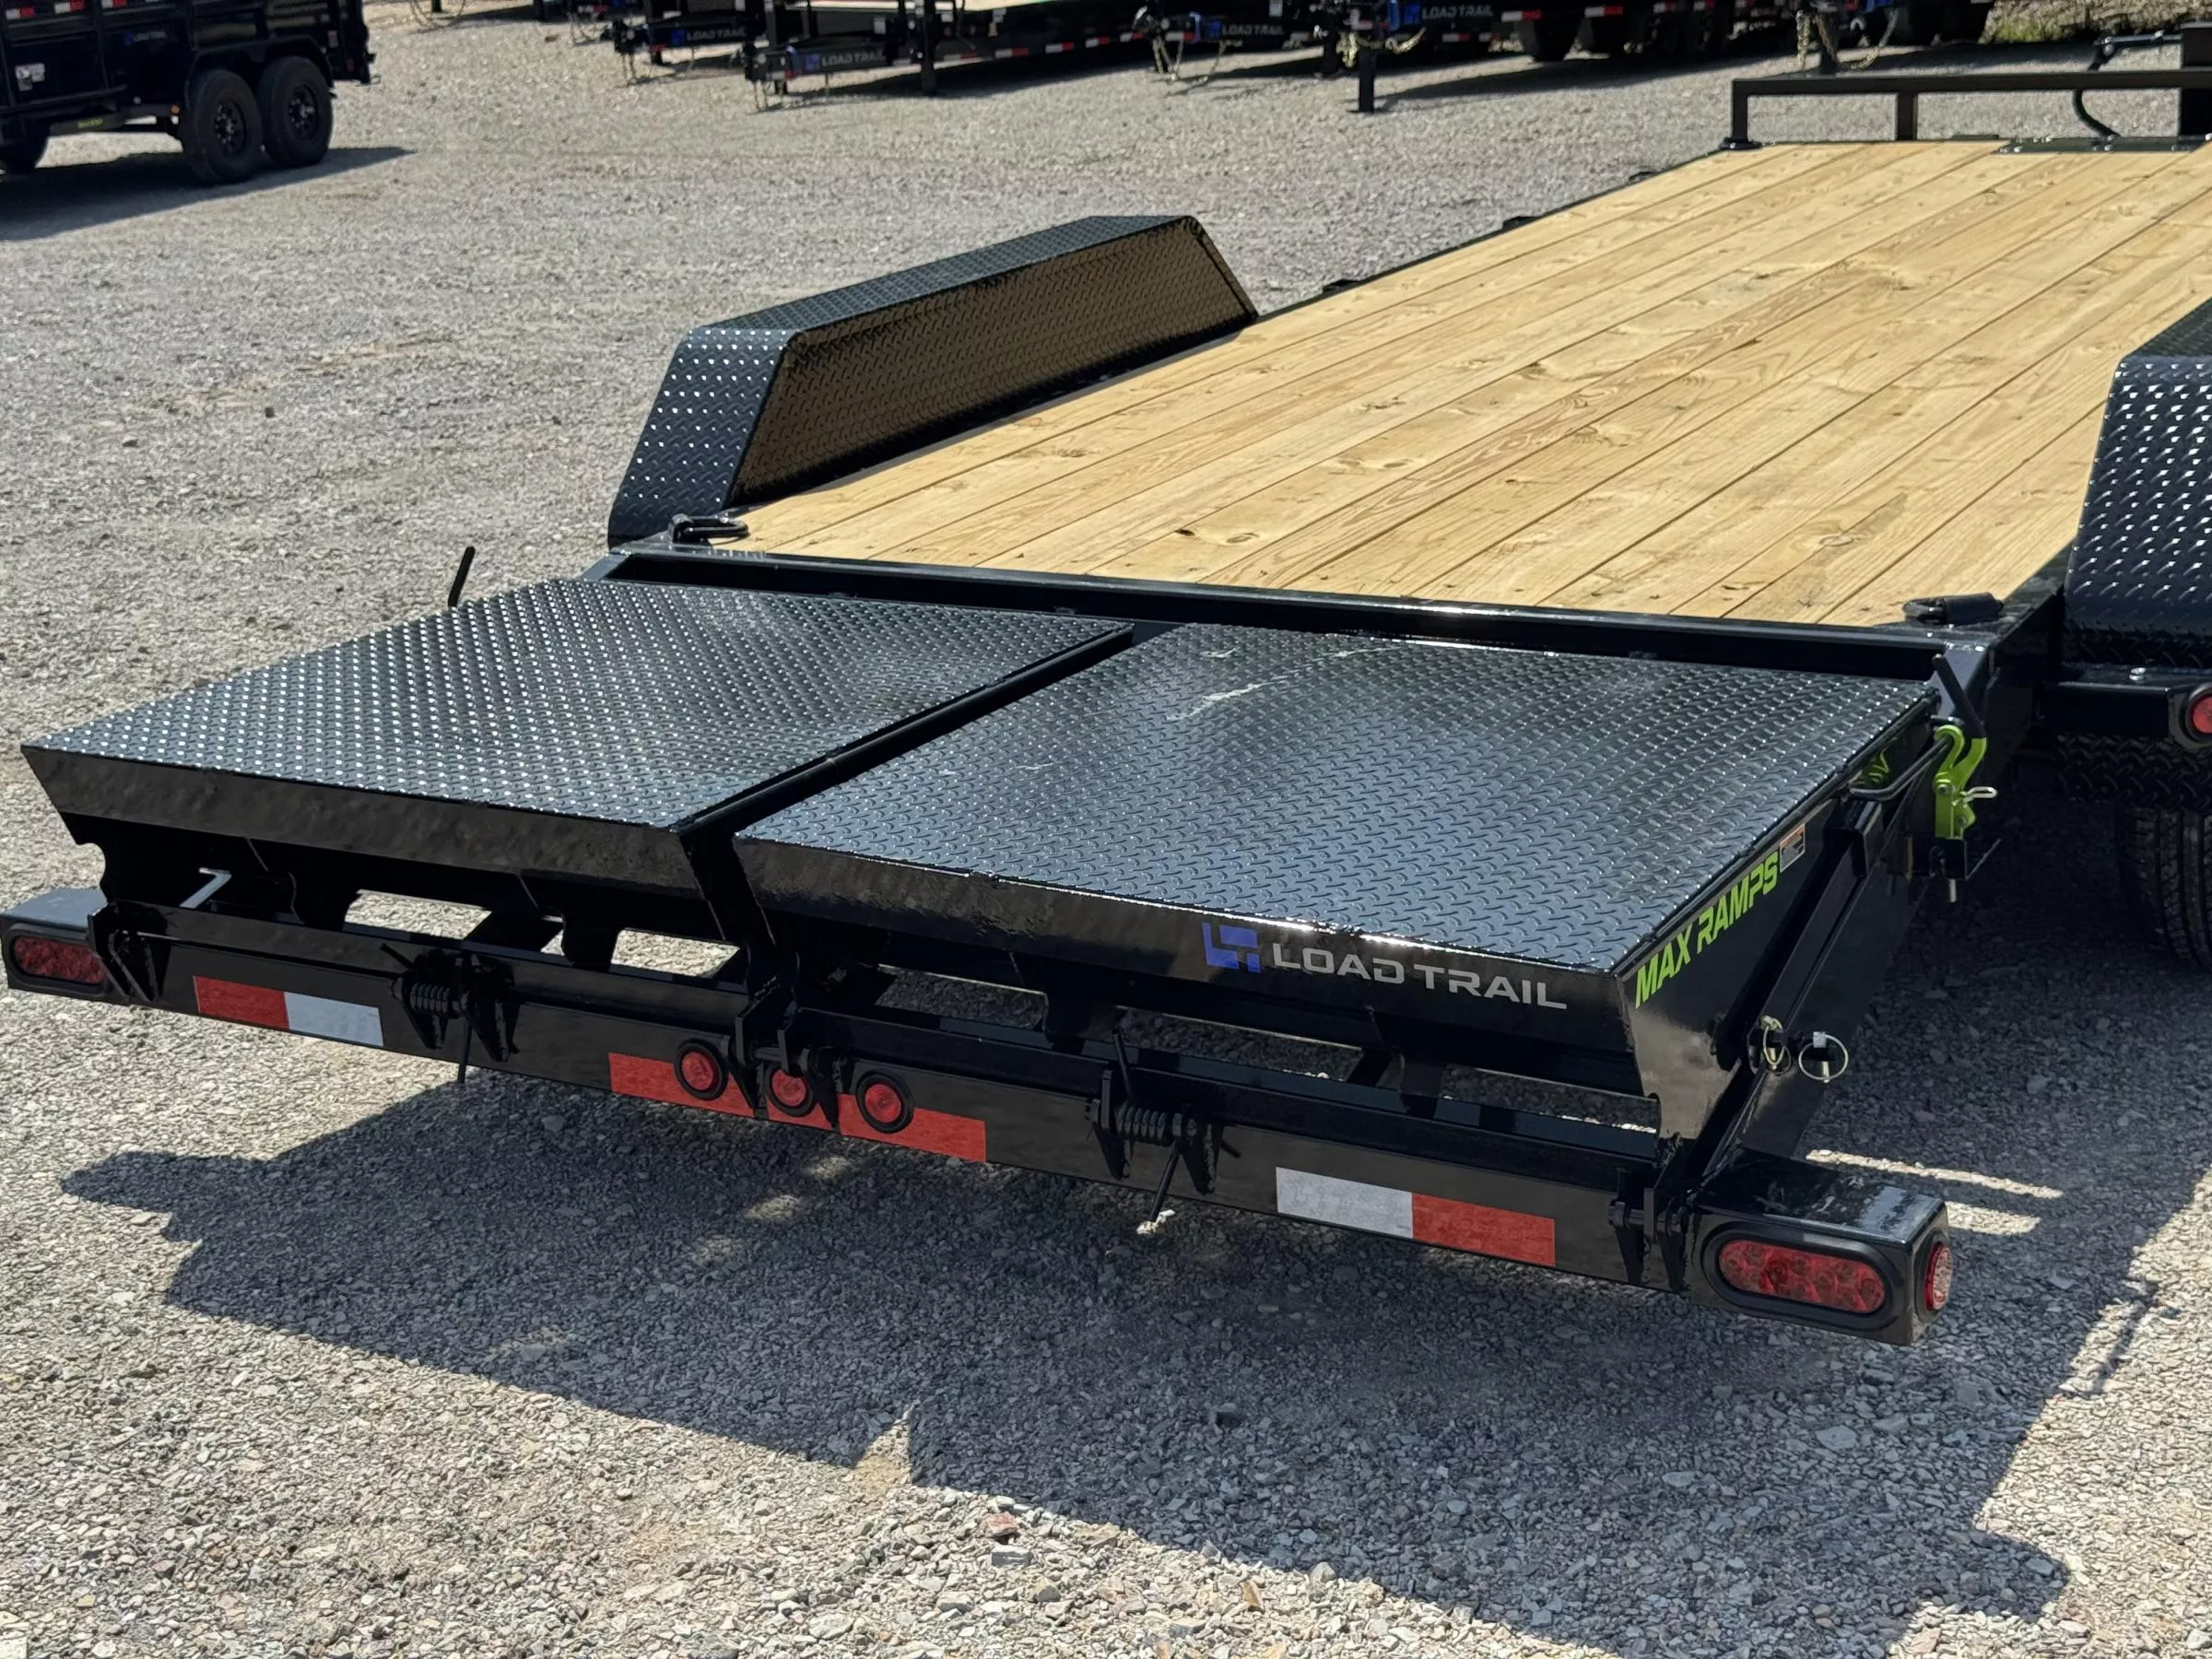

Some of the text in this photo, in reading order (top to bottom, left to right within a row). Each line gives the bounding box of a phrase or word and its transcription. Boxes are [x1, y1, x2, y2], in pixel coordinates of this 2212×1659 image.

[1422, 4, 1494, 20] LOAD TRAIL
[1222, 22, 1285, 36] LOAD TRAIL
[821, 52, 853, 66] LOAD
[1635, 852, 1779, 1009] MAX RAMPS
[1273, 942, 1568, 1010] LOAD TRAIL
